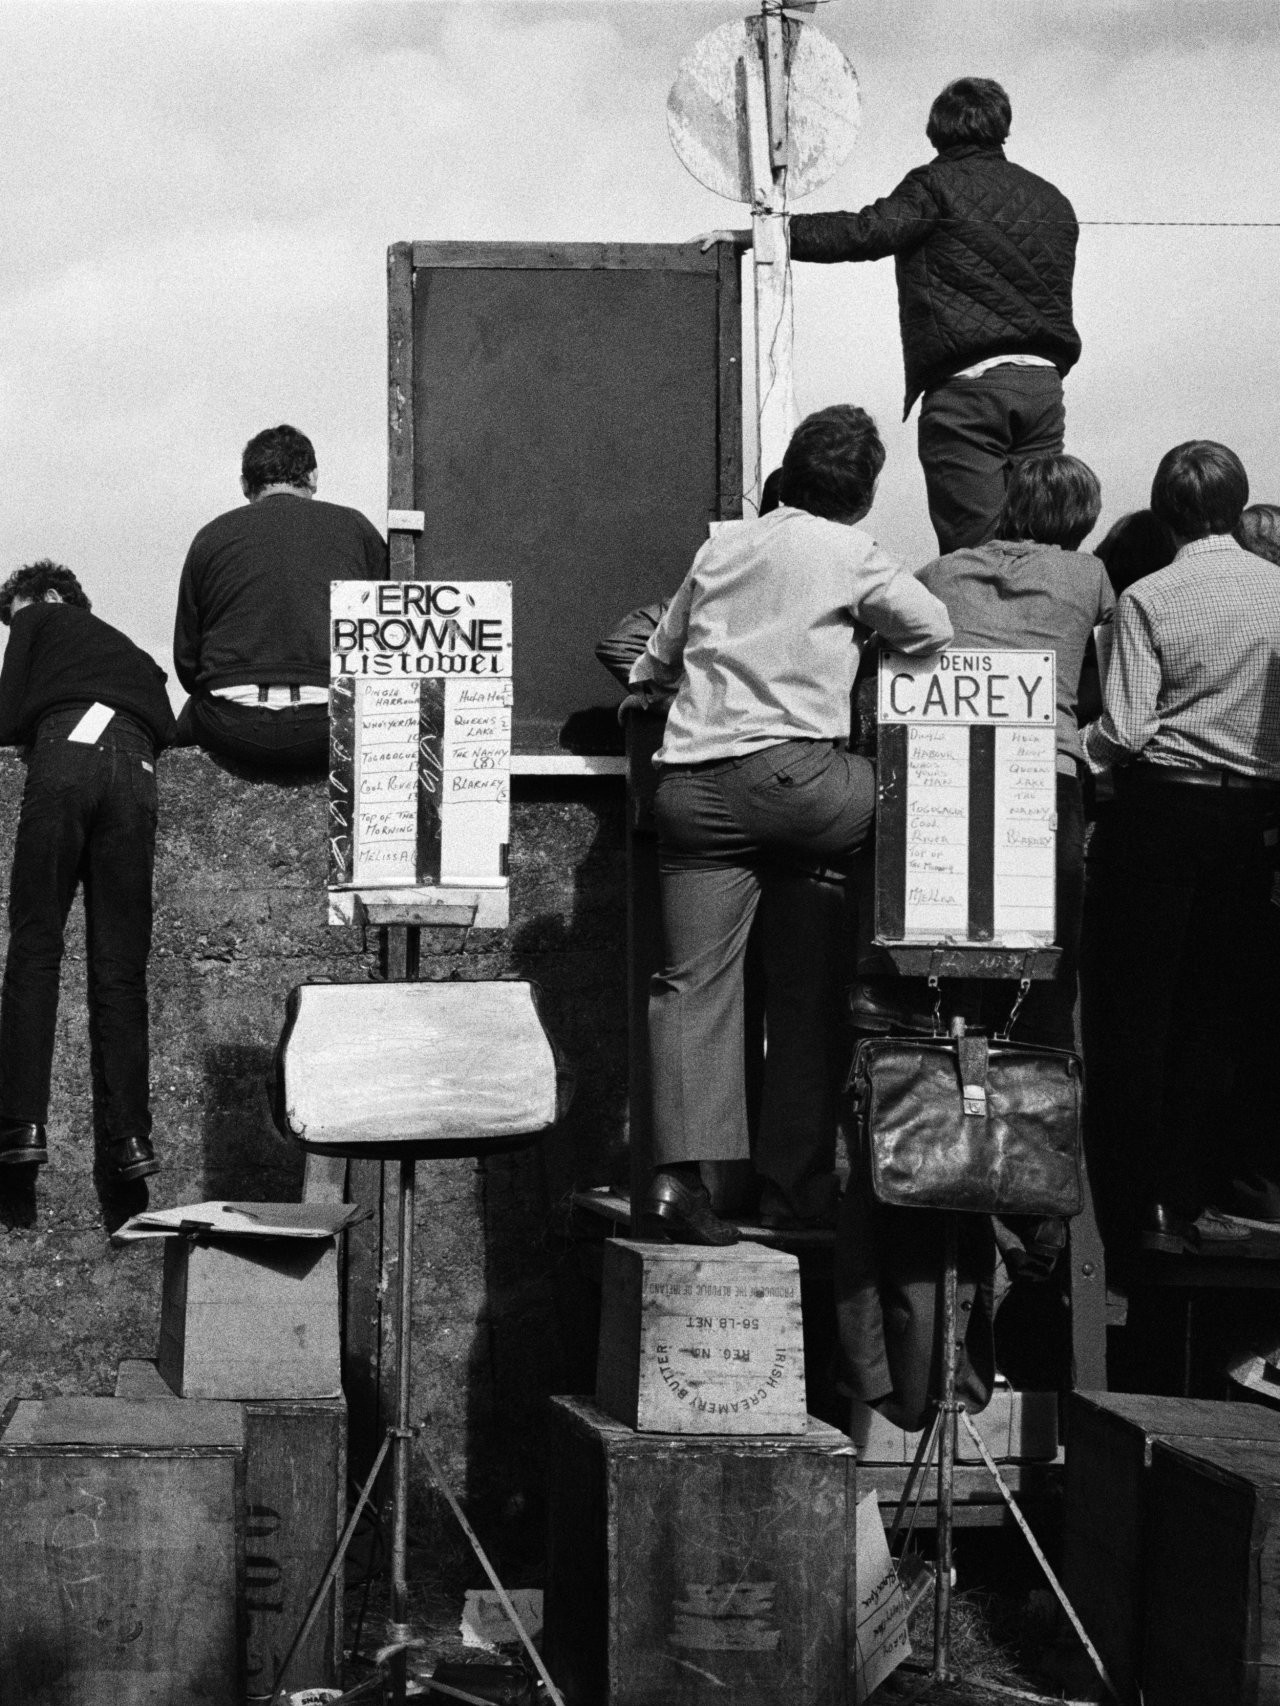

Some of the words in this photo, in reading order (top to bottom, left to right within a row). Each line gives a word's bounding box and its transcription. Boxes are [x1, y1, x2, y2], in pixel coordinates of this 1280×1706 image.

[376, 584, 461, 618] ERIC
[331, 618, 503, 653] BROWNE
[940, 655, 992, 672] DENIS
[890, 672, 1043, 718] CAREY
[686, 1316, 713, 1328] NET
[656, 1344, 689, 1399] BUTTER
[766, 1348, 787, 1389] IRISH
[688, 1388, 768, 1414] CREAMERY
